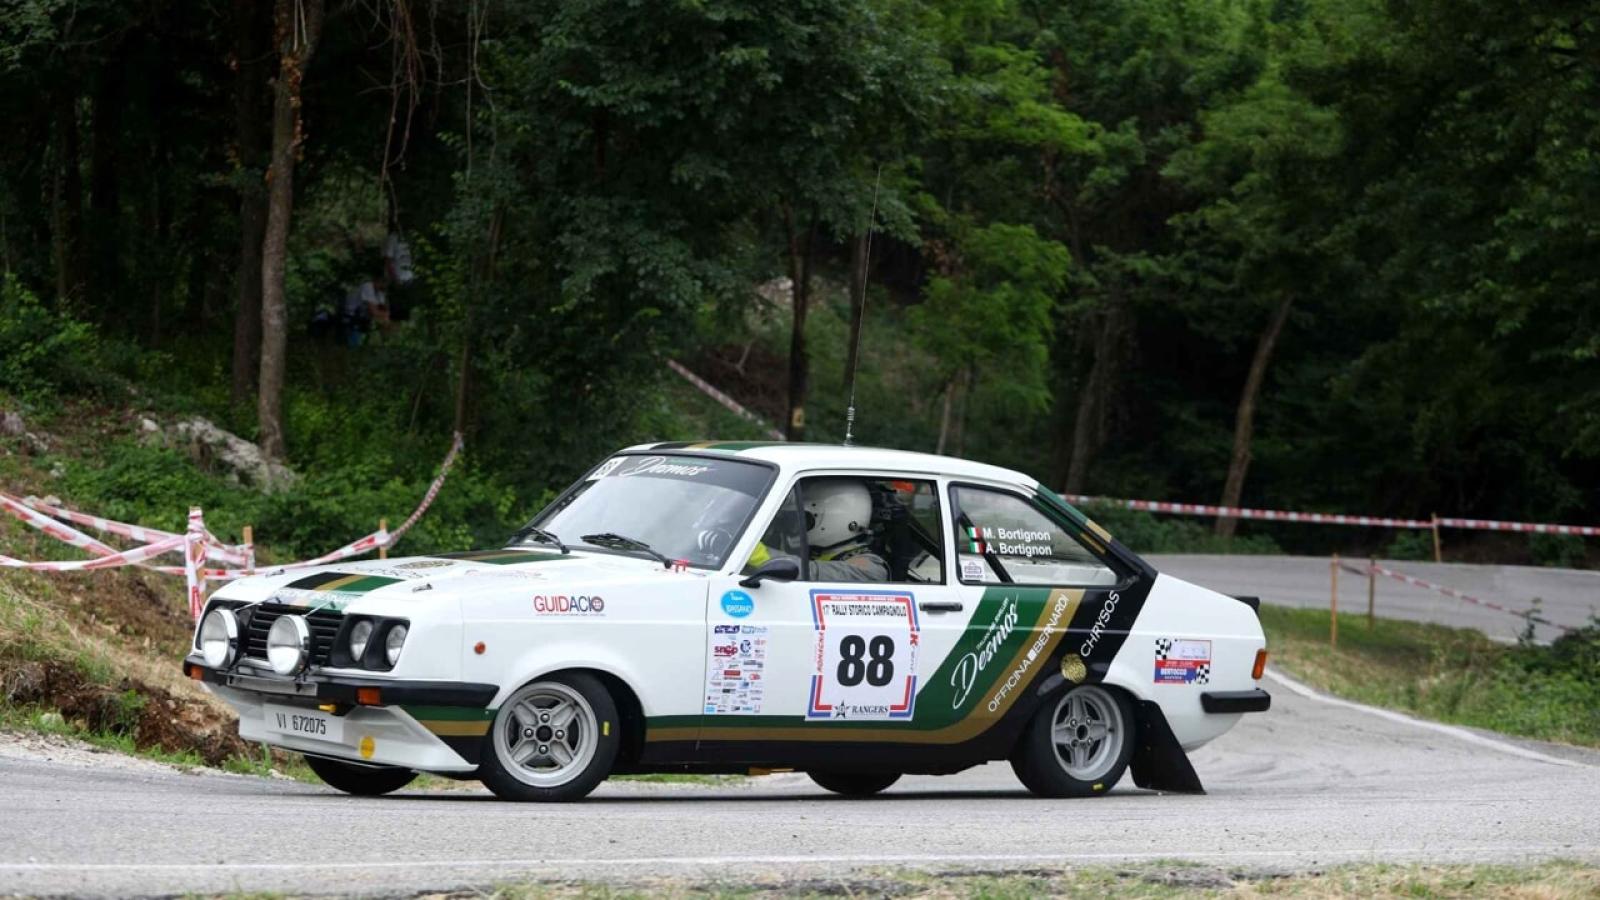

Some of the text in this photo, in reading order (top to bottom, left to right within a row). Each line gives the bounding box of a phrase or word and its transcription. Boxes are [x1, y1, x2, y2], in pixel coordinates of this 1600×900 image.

[983, 528, 1051, 543] M. Bortignon
[986, 542, 1052, 557] A. Bortignon
[832, 604, 847, 616] RALLY
[848, 604, 871, 616] STORICO
[872, 604, 906, 617] CAMPAGNOLO
[1081, 590, 1120, 657] CHRYSOS
[836, 634, 895, 687] 88
[951, 594, 1019, 710] Desmos
[988, 594, 1070, 712] OFFICINA BERNARDI
[852, 705, 889, 714] RANGERS
[276, 712, 327, 735] VI 672075
